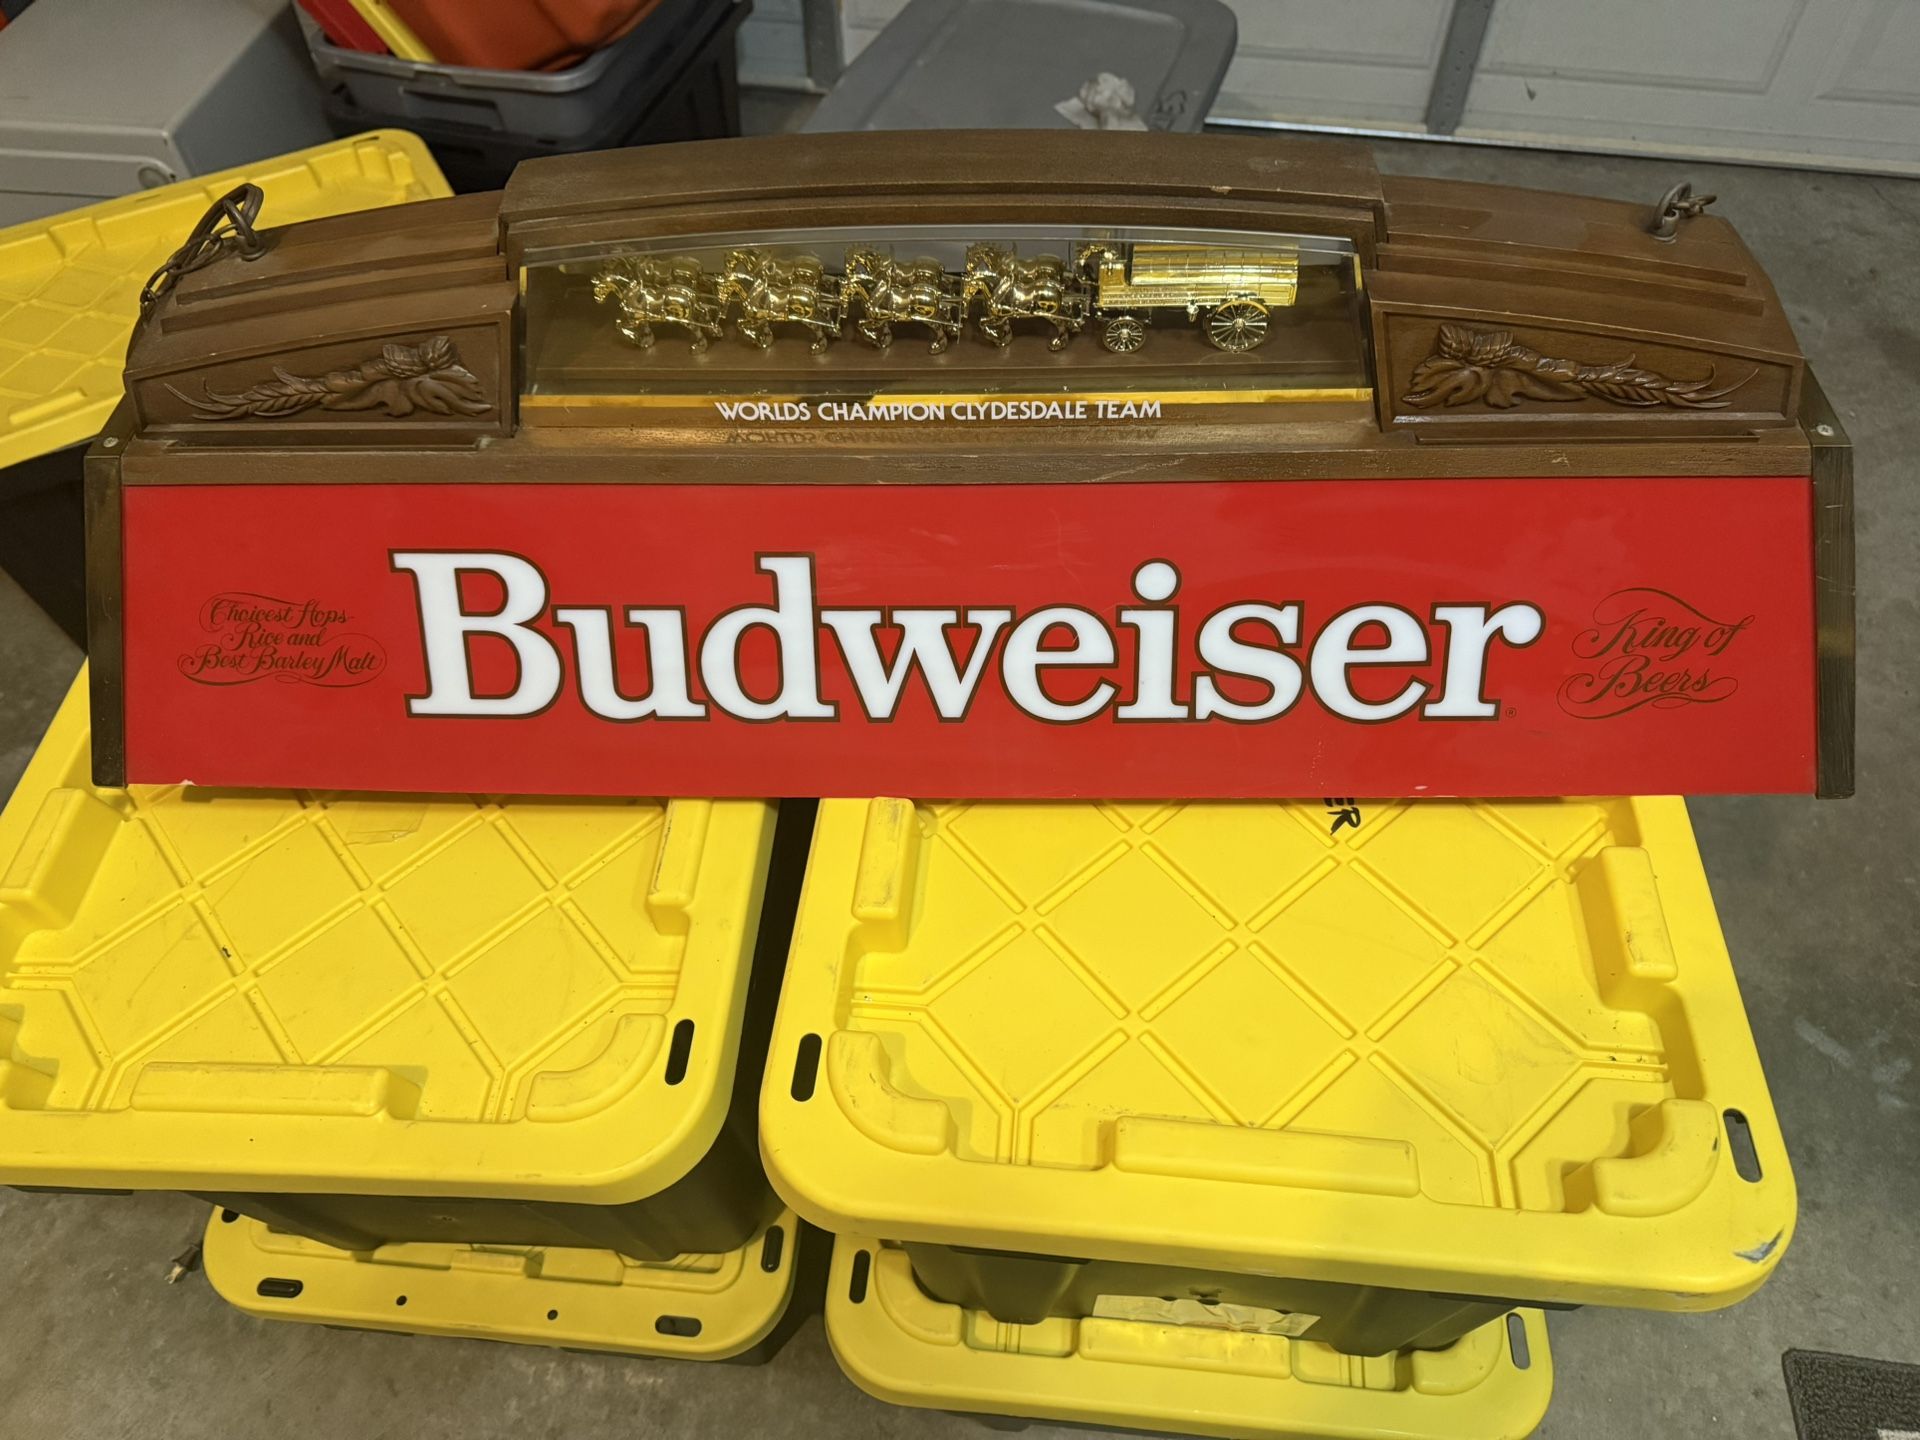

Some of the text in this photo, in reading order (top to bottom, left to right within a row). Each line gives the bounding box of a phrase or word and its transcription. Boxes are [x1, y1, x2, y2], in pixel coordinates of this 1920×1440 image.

[714, 400, 1162, 422] WORLDS CHAMPION CLYDESDALE TEAM
[205, 597, 349, 628] Choicest Hops
[221, 621, 327, 651] Rice and
[388, 549, 1545, 723] Budweiser
[1571, 606, 1755, 662] King of
[184, 644, 379, 678] Best Barley Malt
[1561, 654, 1724, 708] Beers
